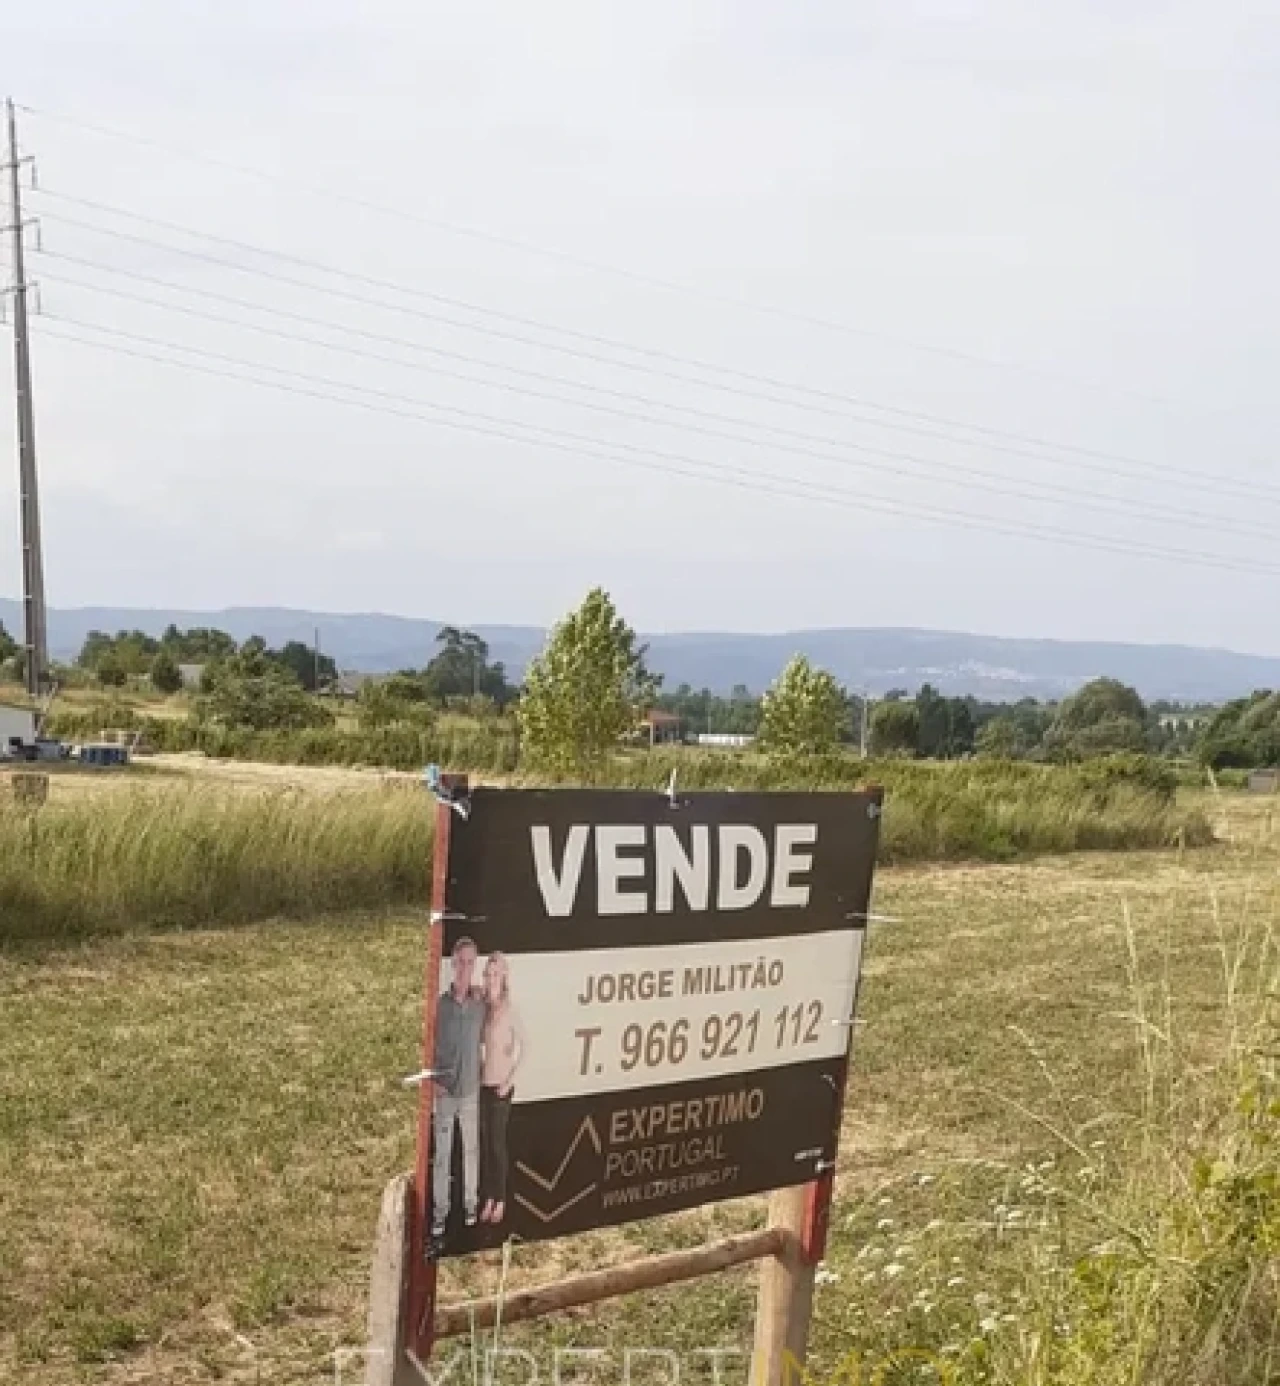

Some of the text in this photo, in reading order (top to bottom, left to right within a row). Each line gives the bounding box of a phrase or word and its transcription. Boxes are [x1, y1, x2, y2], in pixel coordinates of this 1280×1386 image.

[530, 823, 819, 917] VENDE
[577, 955, 784, 1006] JORGE MILITÃO
[574, 999, 824, 1076] T. 966 921 112
[609, 1088, 764, 1145] EXPERTIMO
[603, 1132, 726, 1180] PORTUGAL
